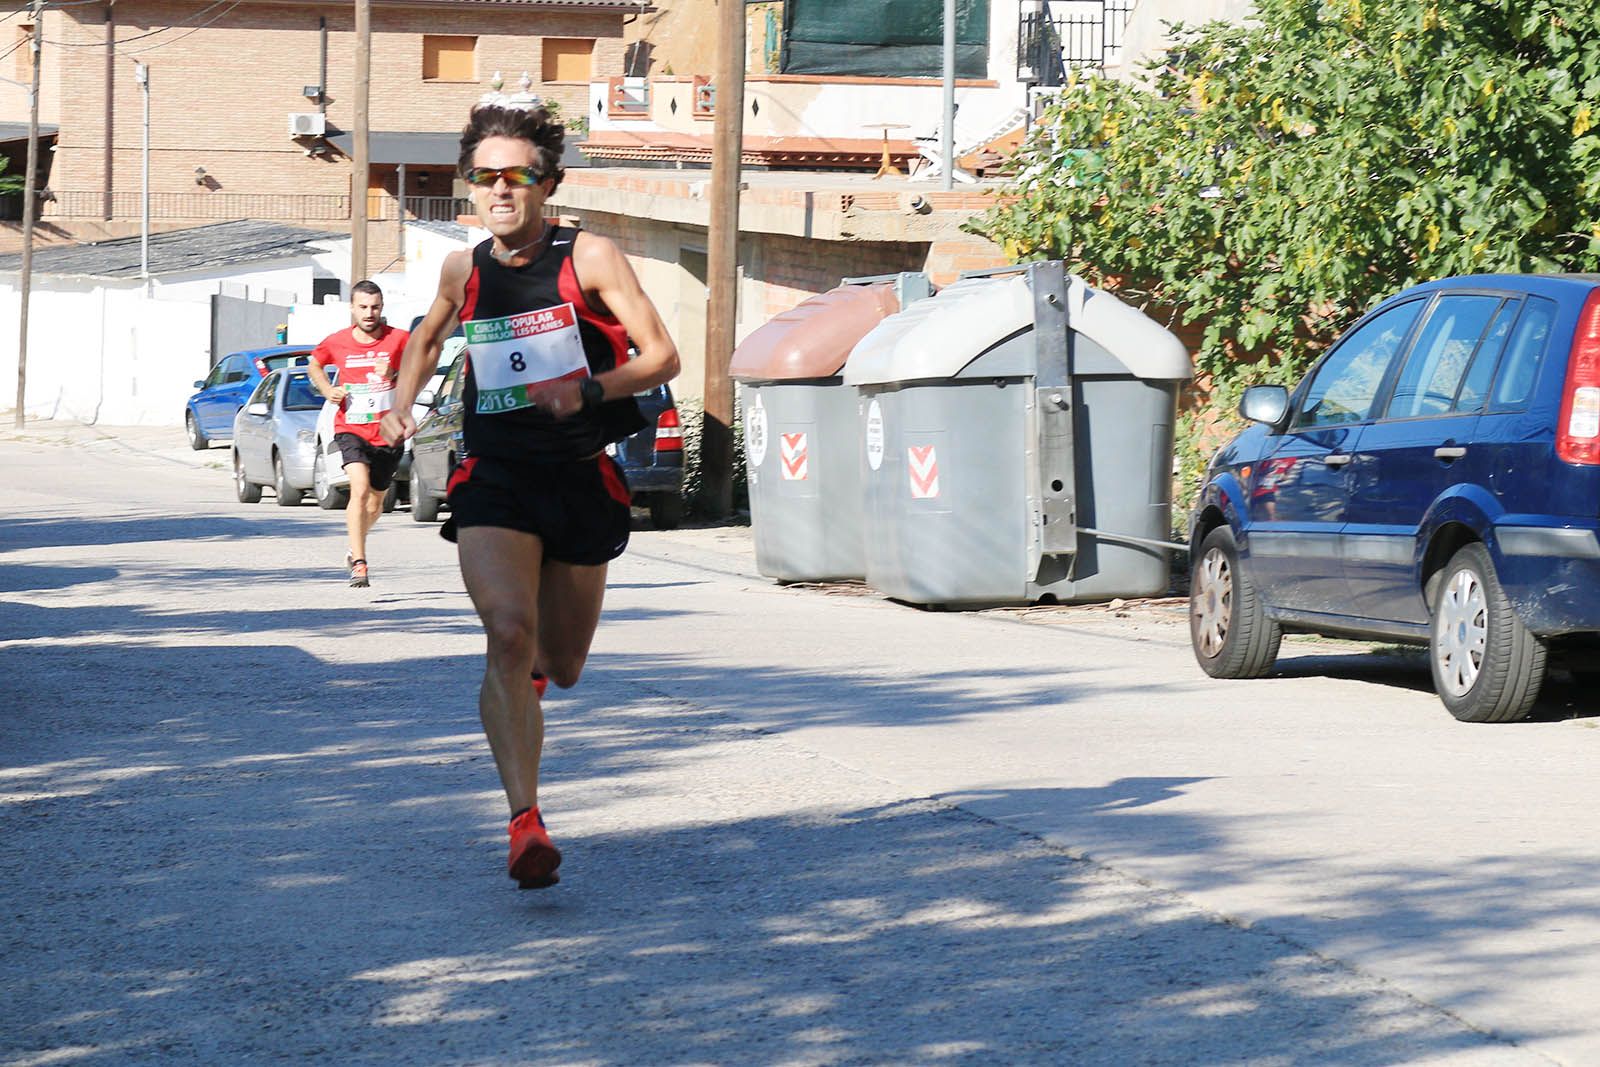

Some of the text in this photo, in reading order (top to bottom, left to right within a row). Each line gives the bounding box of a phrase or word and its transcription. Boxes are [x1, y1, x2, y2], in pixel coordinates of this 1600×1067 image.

[504, 311, 554, 329] POPULAR
[488, 330, 515, 341] MAJOR
[517, 327, 529, 336] LES
[531, 319, 564, 333] PLANES
[510, 351, 527, 372] 8
[368, 398, 375, 408] 9
[479, 392, 516, 410] 2016
